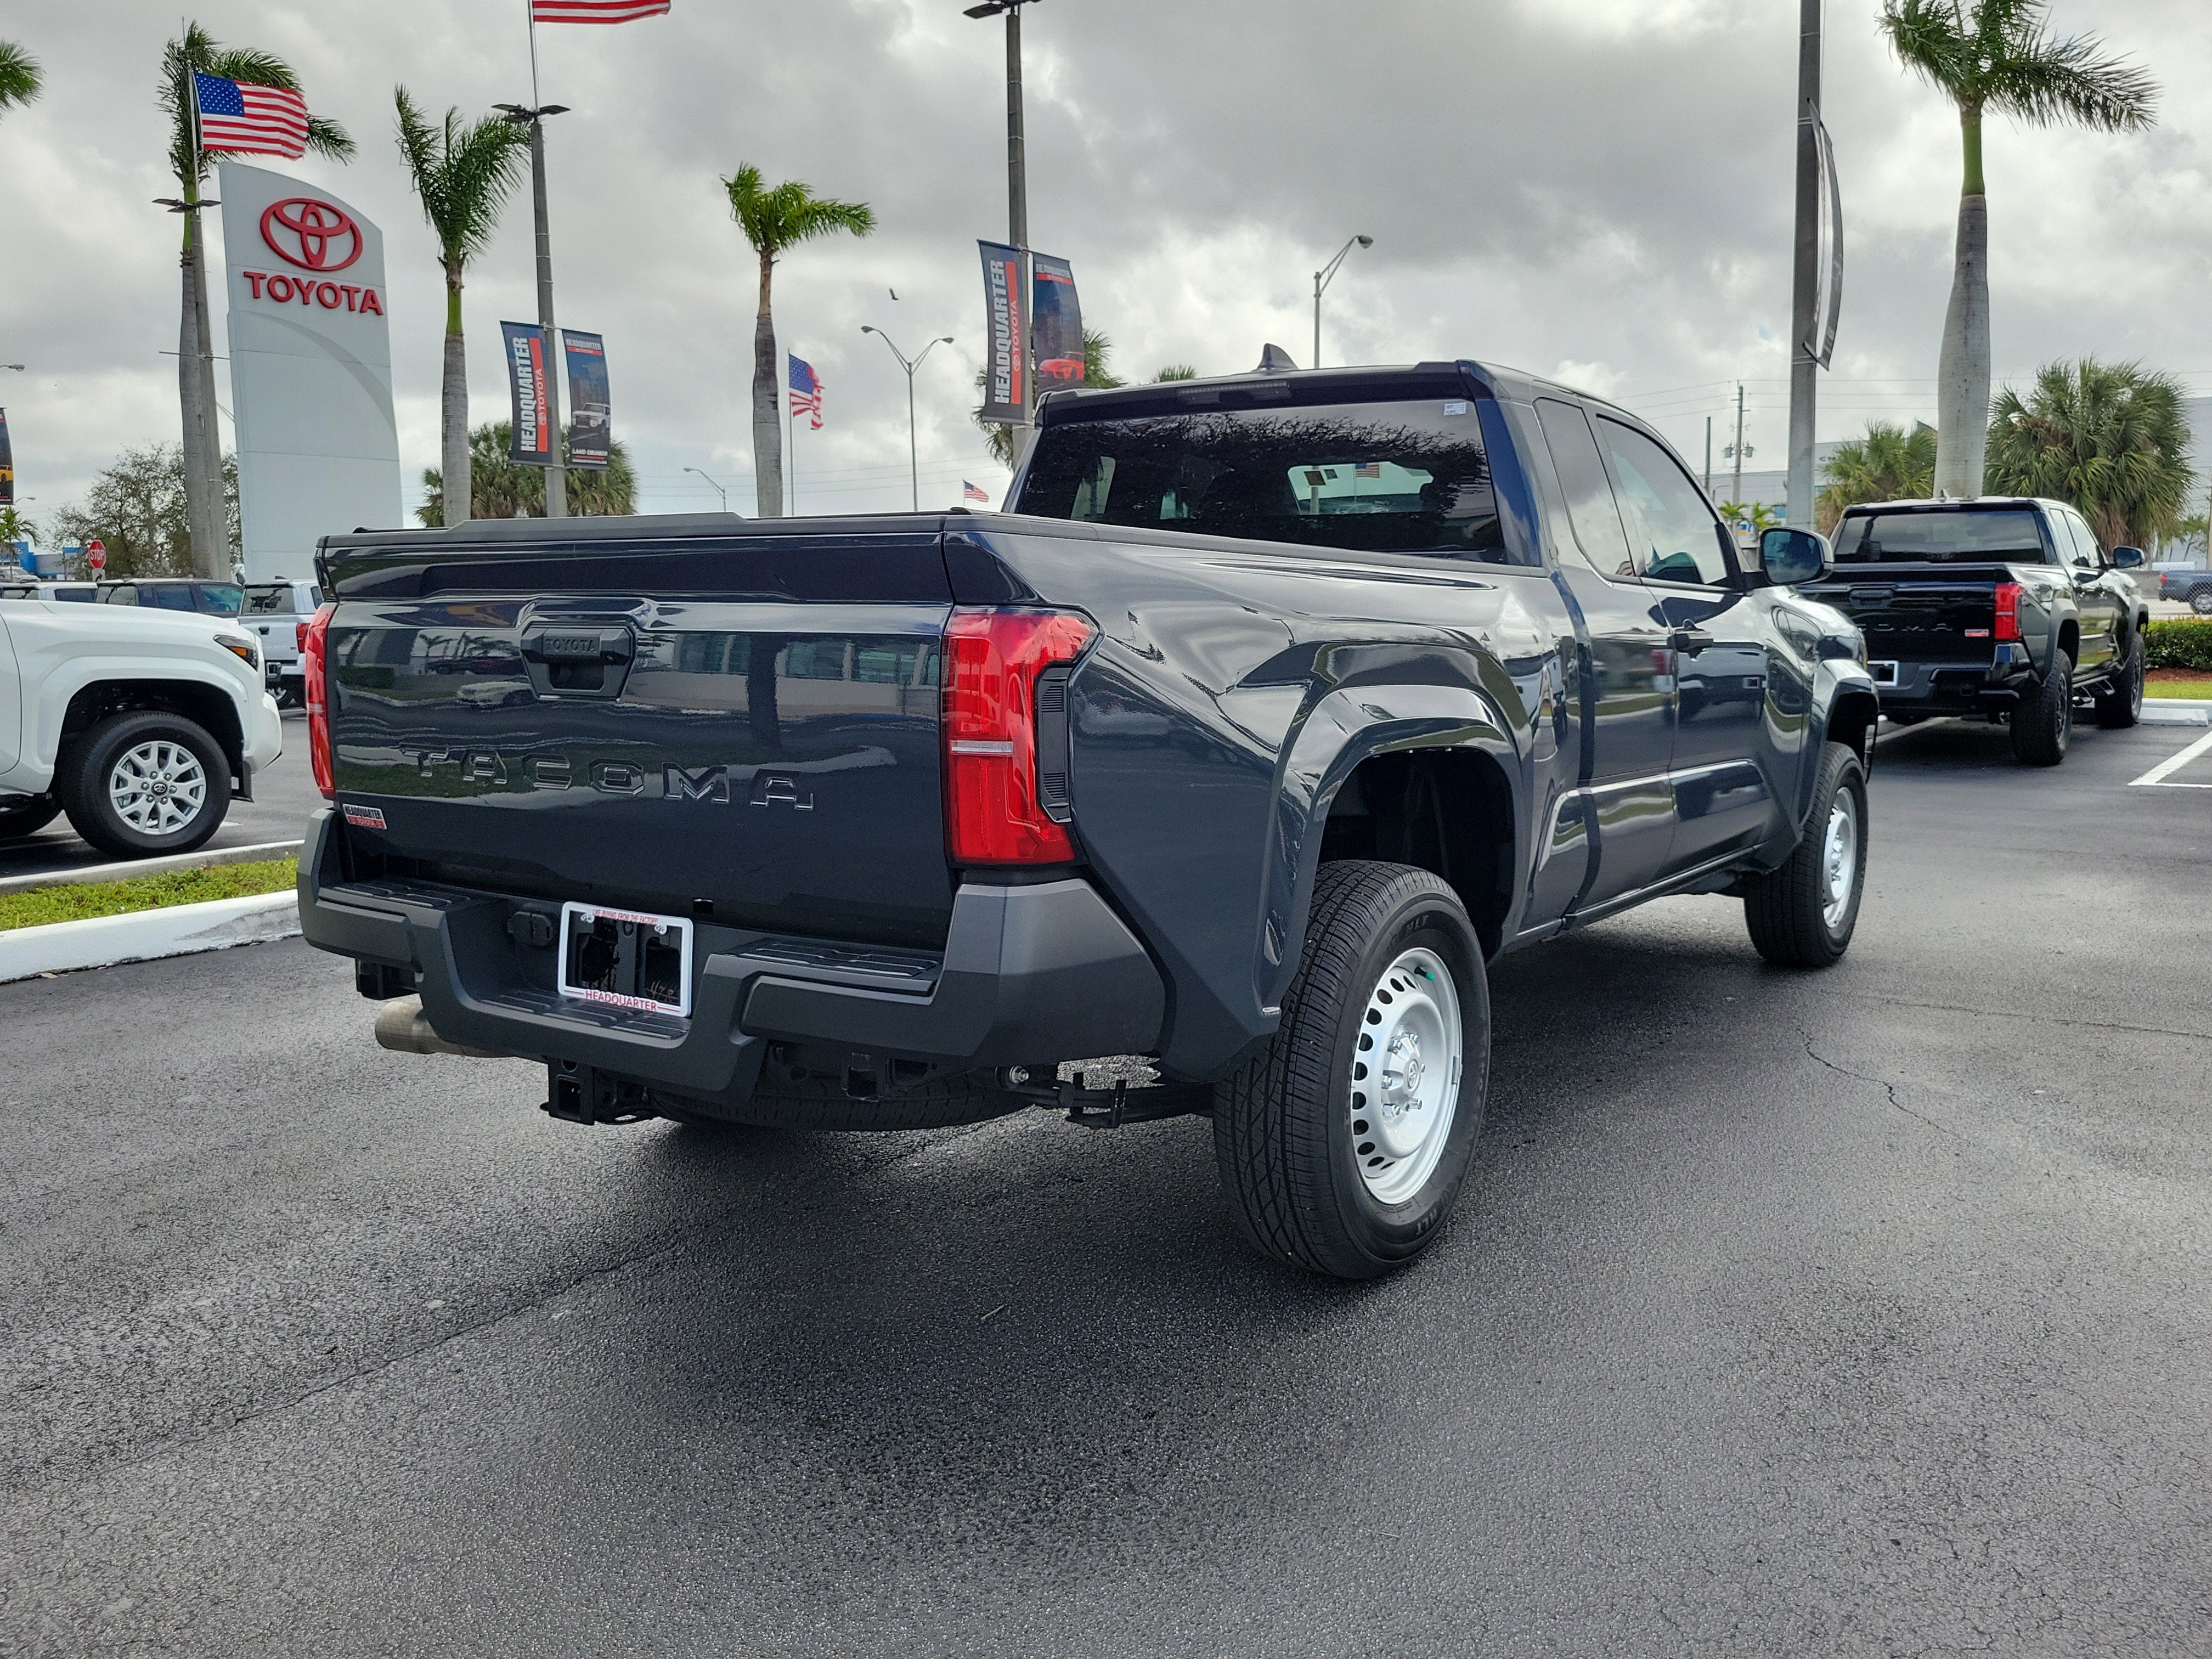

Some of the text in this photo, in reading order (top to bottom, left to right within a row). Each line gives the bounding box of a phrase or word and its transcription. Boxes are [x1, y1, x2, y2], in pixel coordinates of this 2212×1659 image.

[243, 270, 384, 316] TOYOTA
[990, 260, 1012, 404] HEADQUARTER
[1010, 300, 1020, 353] TOYOTA
[512, 336, 537, 452] HEADQUARTER
[535, 368, 546, 411] TOYOTA
[90, 549, 105, 561] STOP
[545, 639, 597, 653] TOYOTA
[398, 742, 815, 811] TACOMA
[585, 989, 657, 1011] HEADQUARTER
